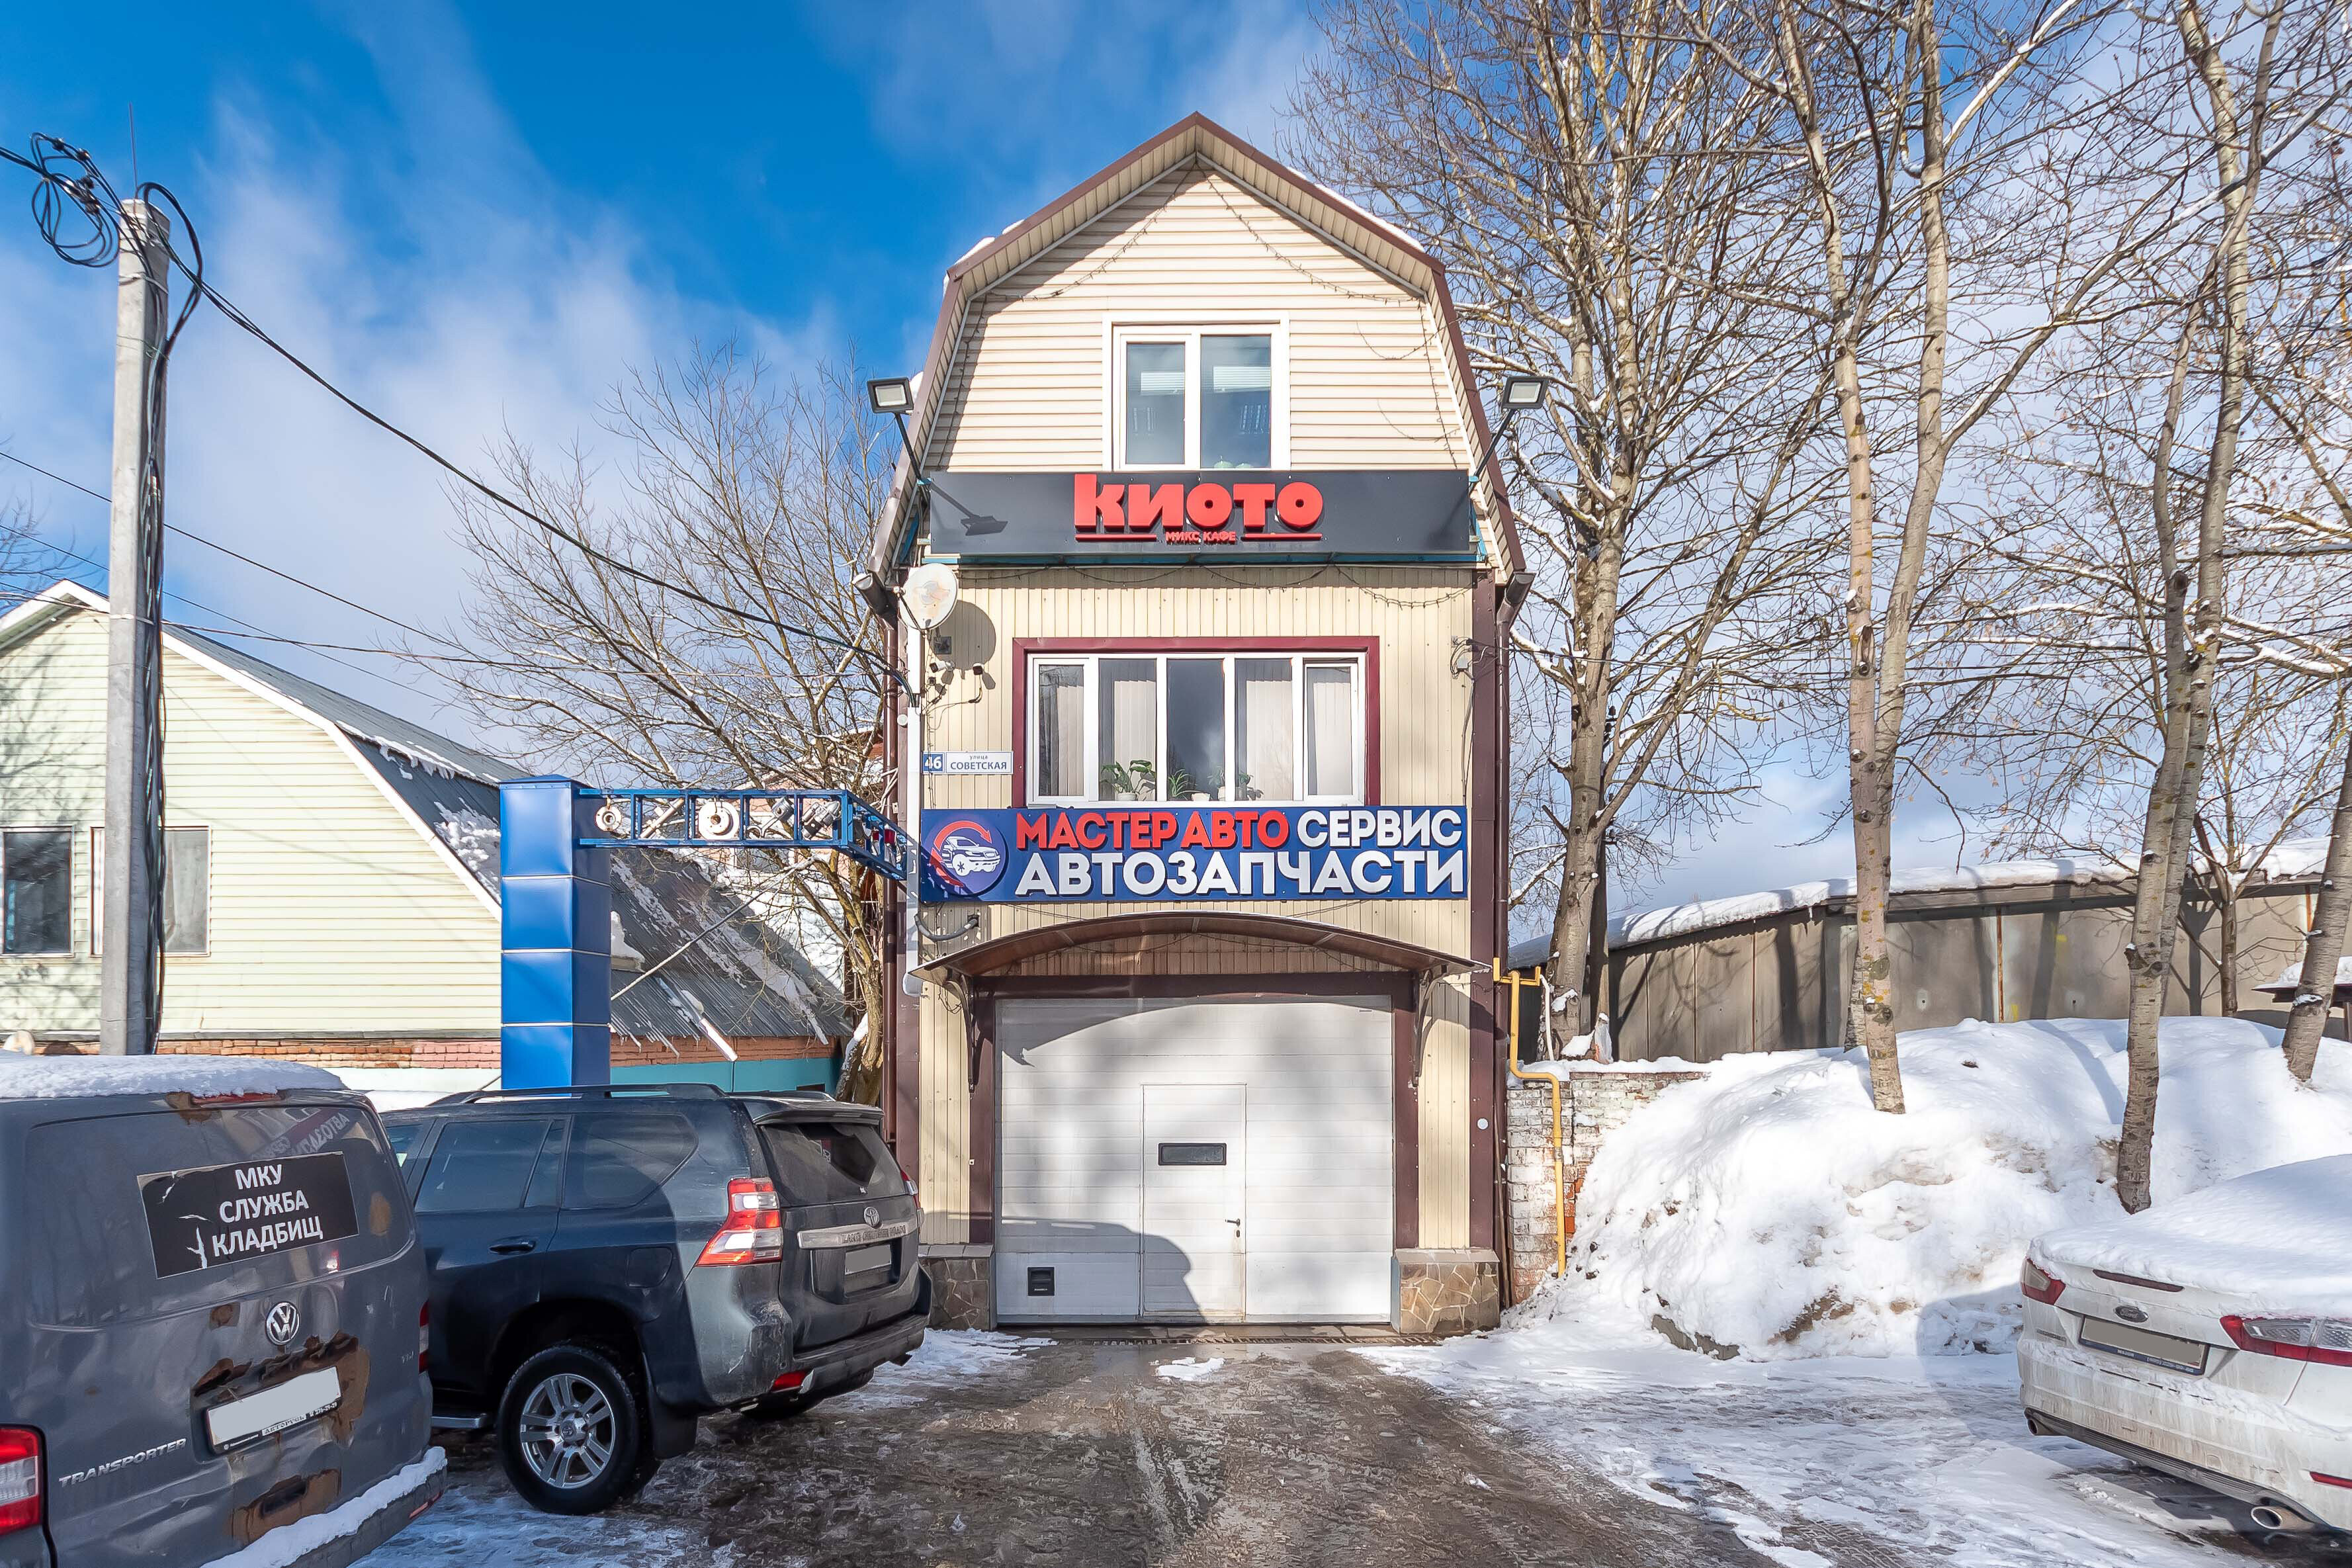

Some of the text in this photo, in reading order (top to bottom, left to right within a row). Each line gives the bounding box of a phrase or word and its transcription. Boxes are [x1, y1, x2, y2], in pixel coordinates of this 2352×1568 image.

[1074, 473, 1324, 532] КИОТО
[1165, 531, 1237, 544] МИКС КАФЕ
[924, 756, 943, 769] 46
[950, 762, 1007, 770] СОВЕТСКАЯ
[1016, 809, 1463, 849] МАСТЕР АВТО СЕРВИС
[1014, 849, 1464, 896] АВТОЗАПЧАСТИ
[235, 1163, 283, 1190] МКУ
[219, 1190, 309, 1223] СЛУЖБА
[211, 1215, 324, 1257] КЛАДБИЩ
[58, 1437, 188, 1488] TRANSPORTER
